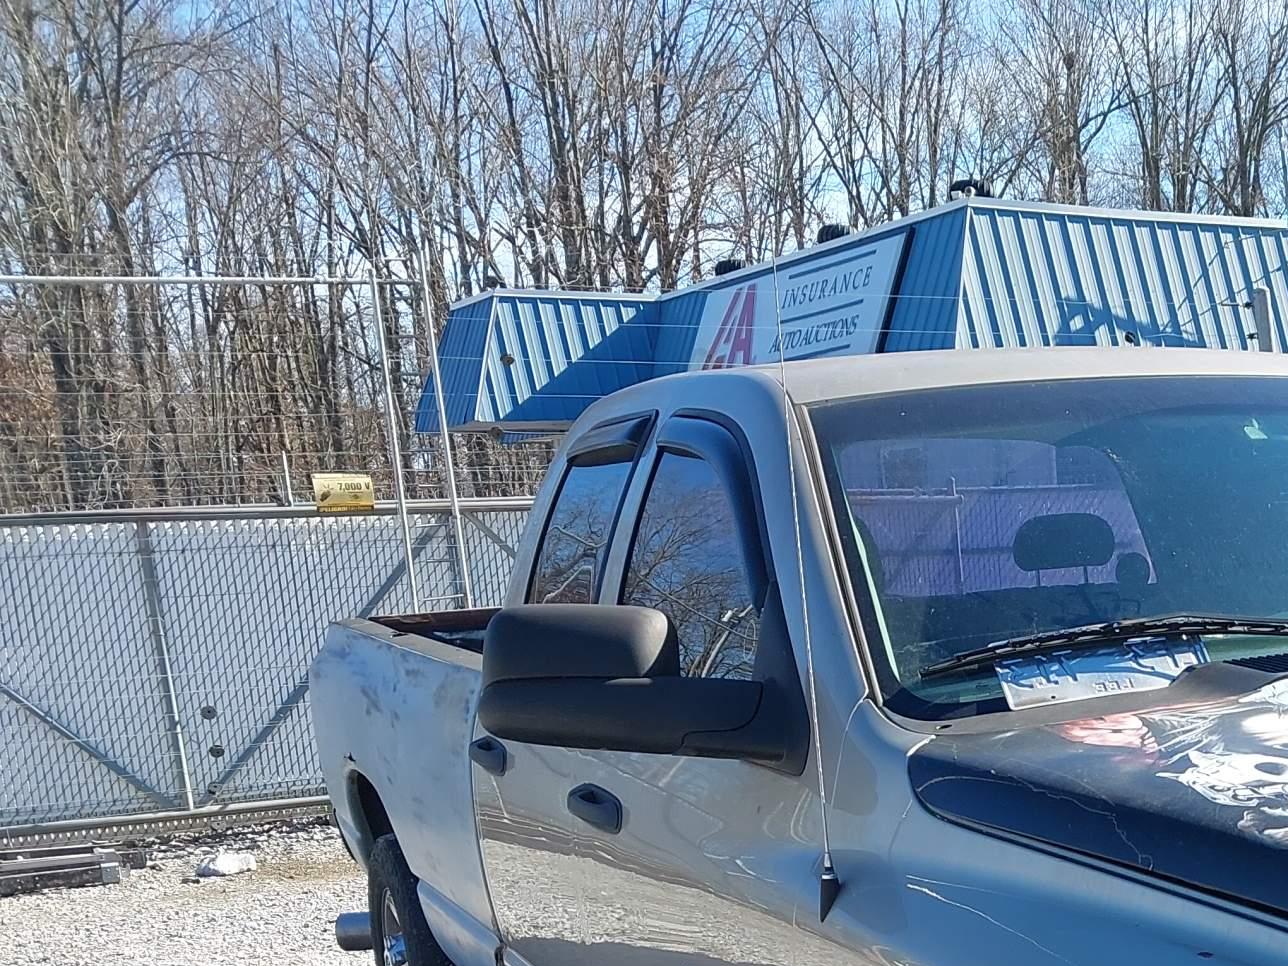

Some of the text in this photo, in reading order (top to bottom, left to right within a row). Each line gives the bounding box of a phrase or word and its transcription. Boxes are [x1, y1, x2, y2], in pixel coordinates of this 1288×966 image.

[781, 266, 872, 309] INSURANCE
[799, 315, 859, 347] AUCTIONS
[337, 482, 370, 492] 7,000 V
